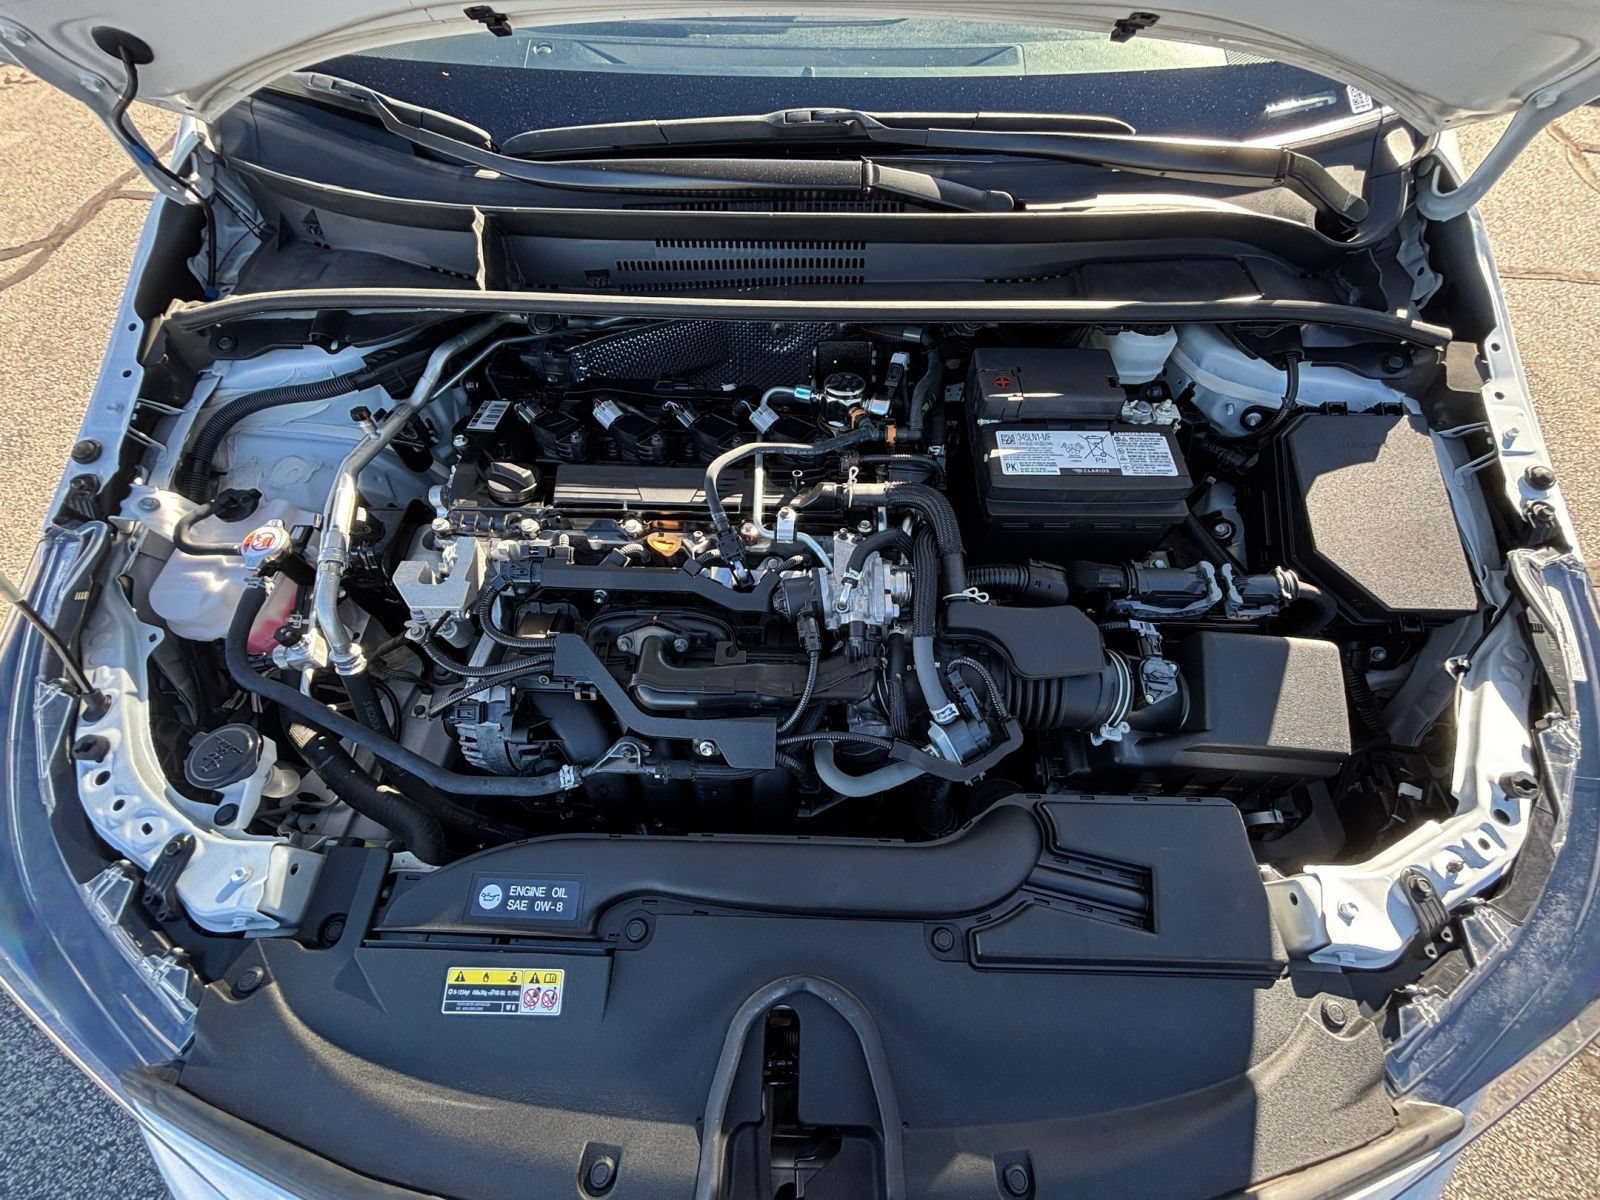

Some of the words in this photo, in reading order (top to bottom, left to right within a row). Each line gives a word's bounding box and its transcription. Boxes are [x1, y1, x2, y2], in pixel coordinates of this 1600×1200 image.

[1006, 462, 1017, 472] PK
[509, 885, 547, 898] ENGINE
[551, 887, 568, 898] OIL
[506, 899, 528, 911] SAE
[534, 900, 563, 912] 0W-8
